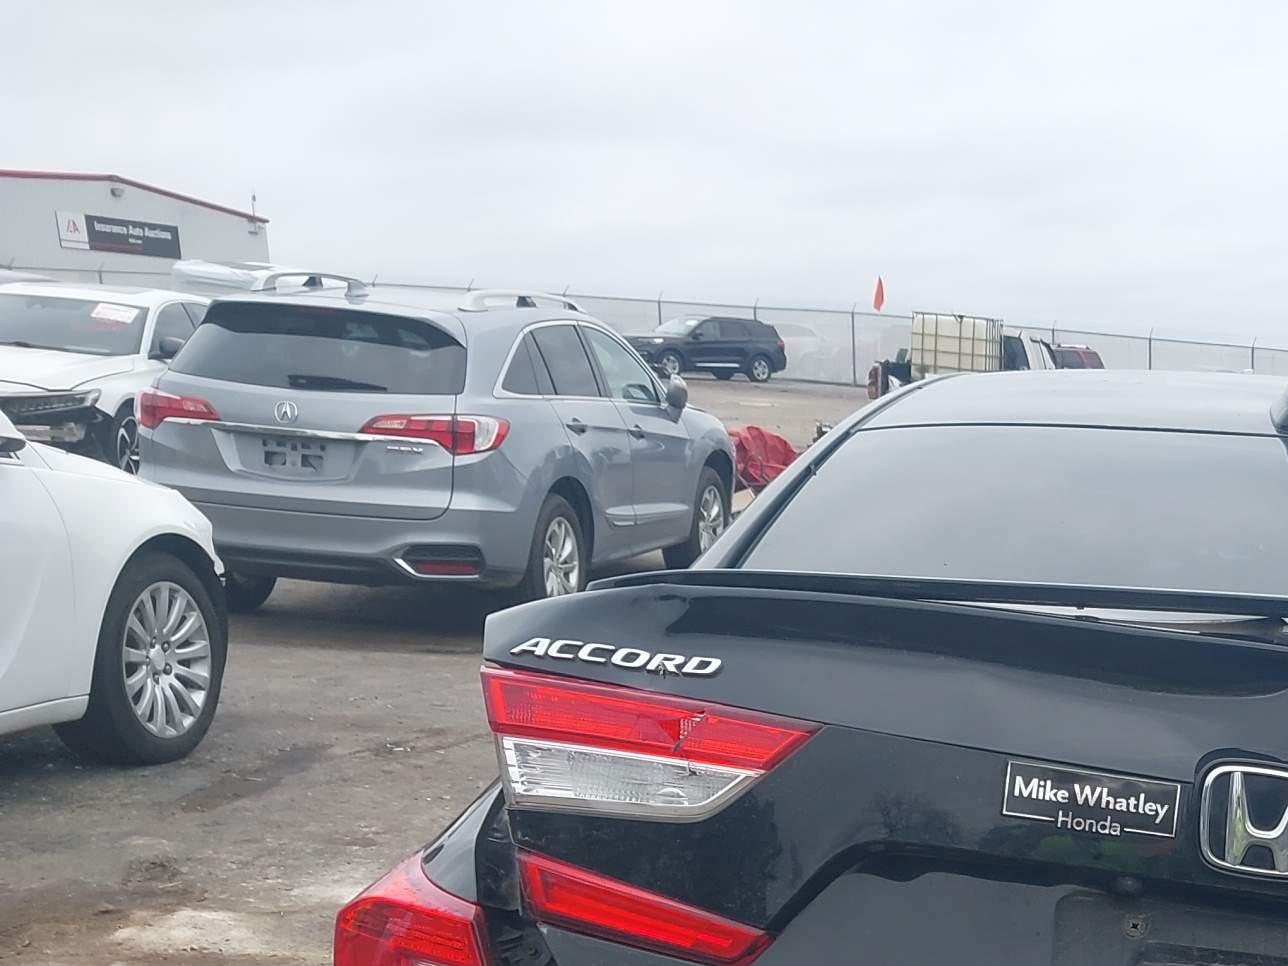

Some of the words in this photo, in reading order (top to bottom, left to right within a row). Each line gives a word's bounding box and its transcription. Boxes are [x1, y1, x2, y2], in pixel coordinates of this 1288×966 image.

[509, 637, 722, 675] ACCORD
[1013, 775, 1069, 804] Mike
[1073, 783, 1170, 825] Whatley
[1056, 810, 1122, 837] Honda
